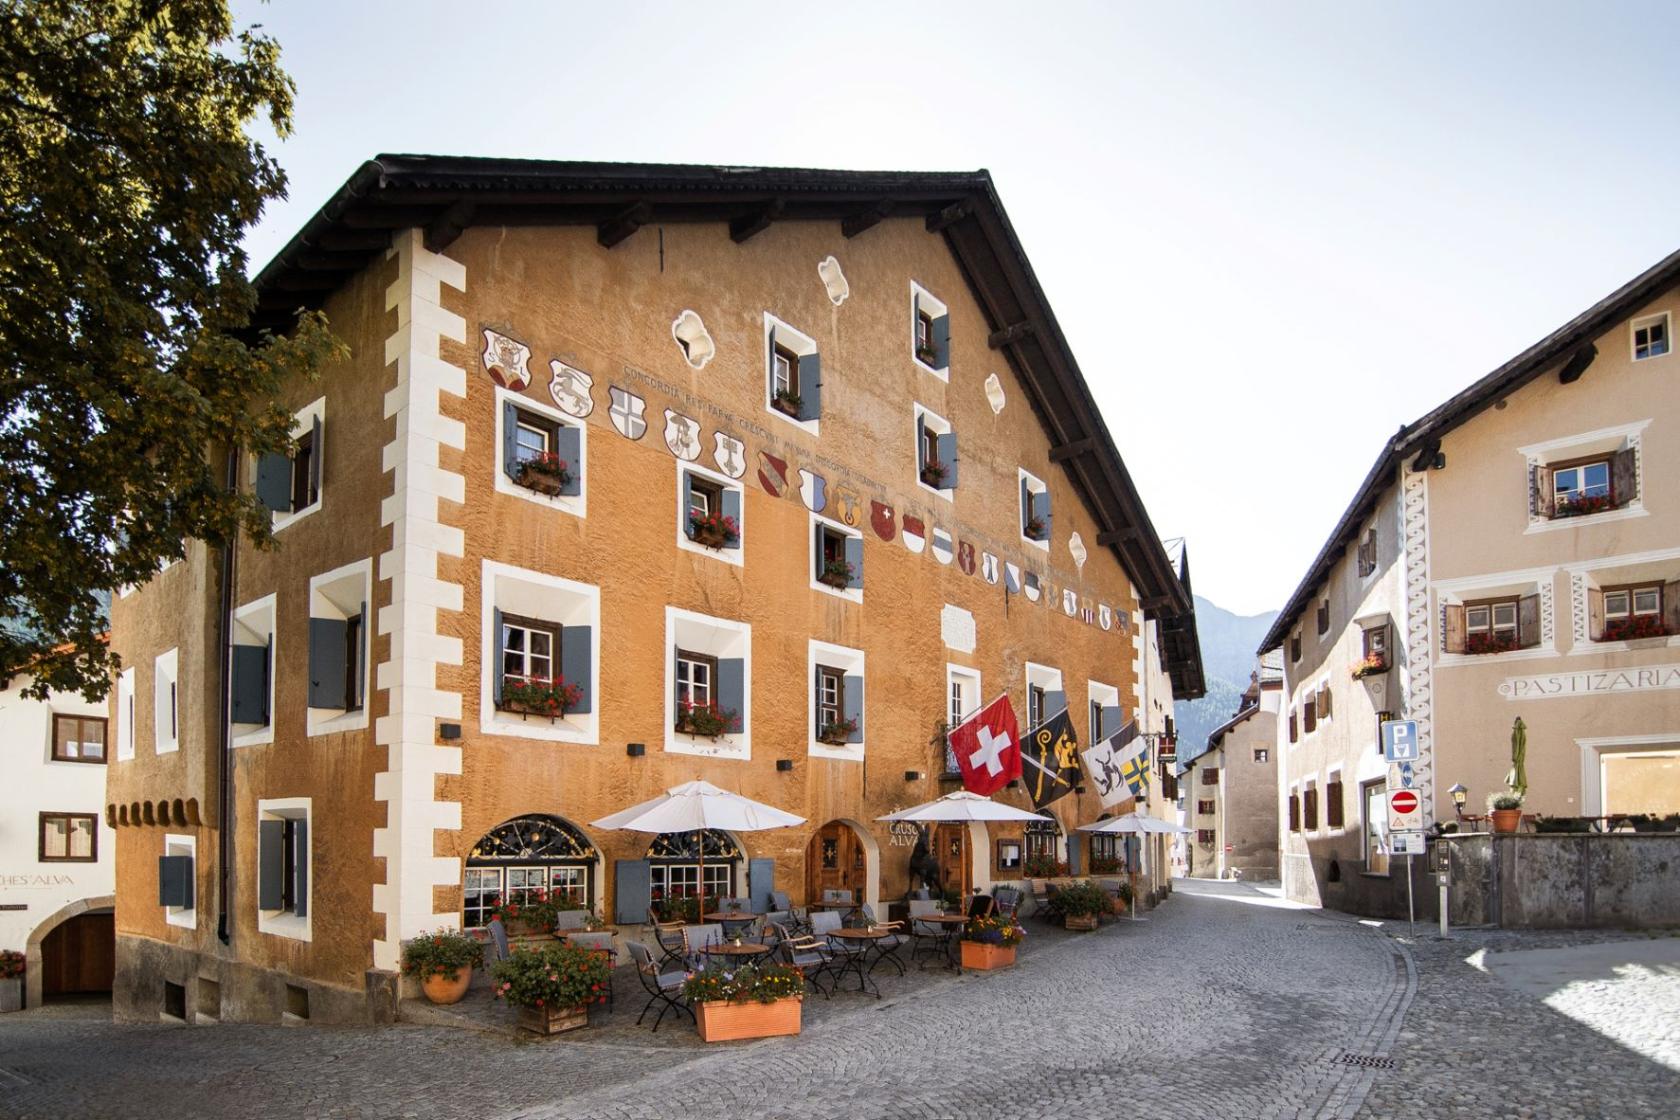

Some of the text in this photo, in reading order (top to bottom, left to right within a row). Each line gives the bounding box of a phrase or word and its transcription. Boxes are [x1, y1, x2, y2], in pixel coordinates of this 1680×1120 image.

[623, 365, 680, 399] CONCORDIA
[1513, 668, 1680, 697] PASTIZARIA
[1393, 724, 1408, 744] P
